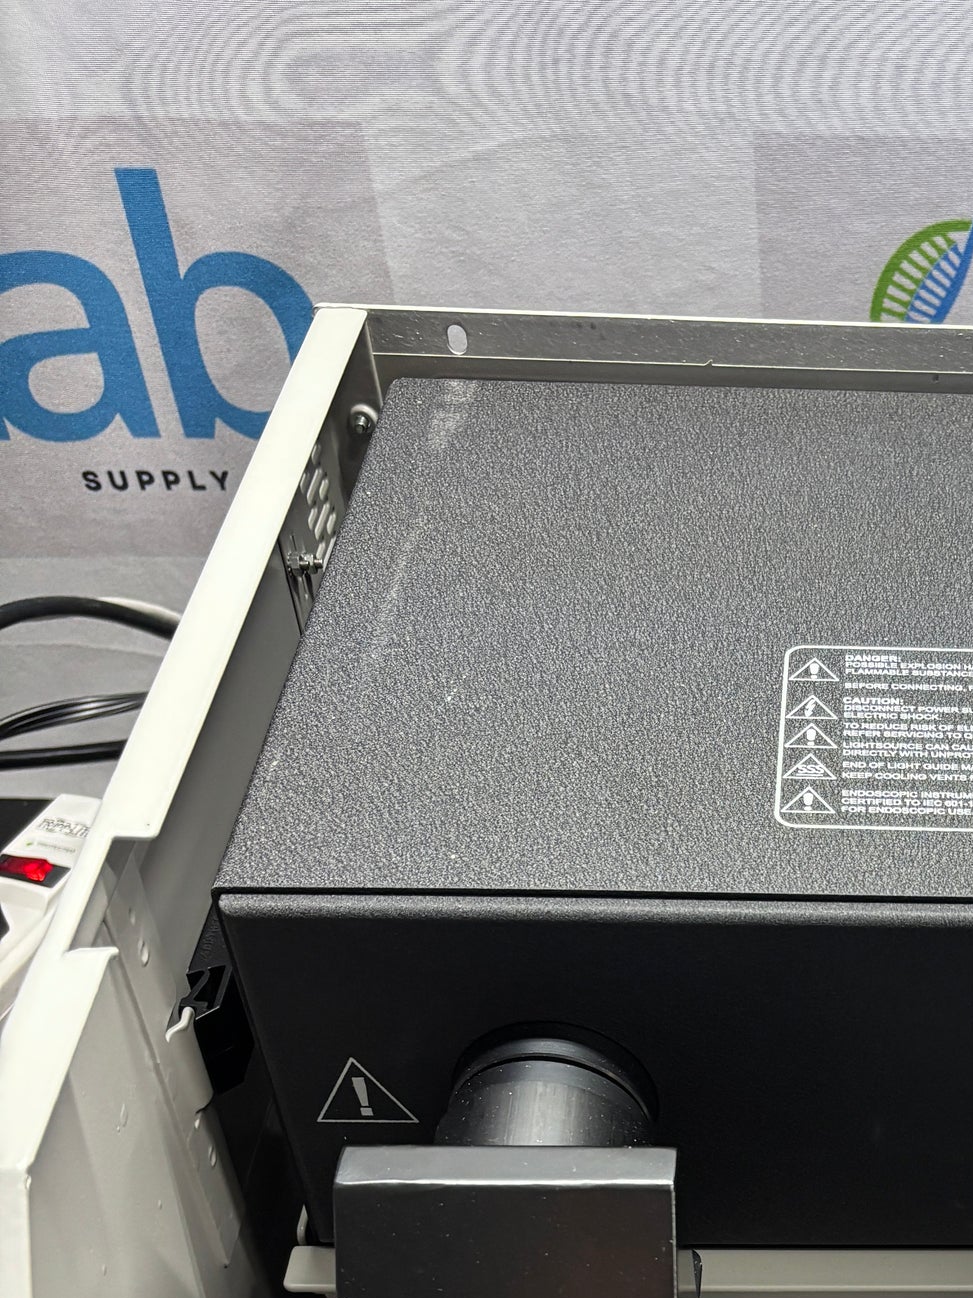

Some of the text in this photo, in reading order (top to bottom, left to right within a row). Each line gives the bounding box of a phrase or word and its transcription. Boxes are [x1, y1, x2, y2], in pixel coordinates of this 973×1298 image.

[0, 168, 313, 443] ab
[82, 470, 230, 492] SUPPLY
[845, 654, 901, 662] DANGER:
[844, 682, 889, 690] BEFORE
[843, 697, 903, 705] CAUTION:
[844, 705, 916, 713] DISCONNECT
[861, 723, 908, 731] REDUCE
[939, 724, 953, 732] OF
[843, 729, 881, 737] REFER
[884, 731, 944, 739] SERVICING
[843, 742, 923, 750] LIGHTSOURCE
[925, 743, 949, 751] CAN
[900, 750, 929, 758] WITH
[843, 761, 867, 769] END
[887, 762, 921, 770] LIGHT
[923, 763, 959, 771] GUIDE
[875, 772, 927, 781] COOLING
[842, 790, 918, 798] ENDOSCOPIC
[842, 797, 901, 806] CERTIFIED
[923, 799, 943, 807] IEC
[841, 806, 866, 814] FOR
[869, 807, 946, 815] ENDOSCOPIC
